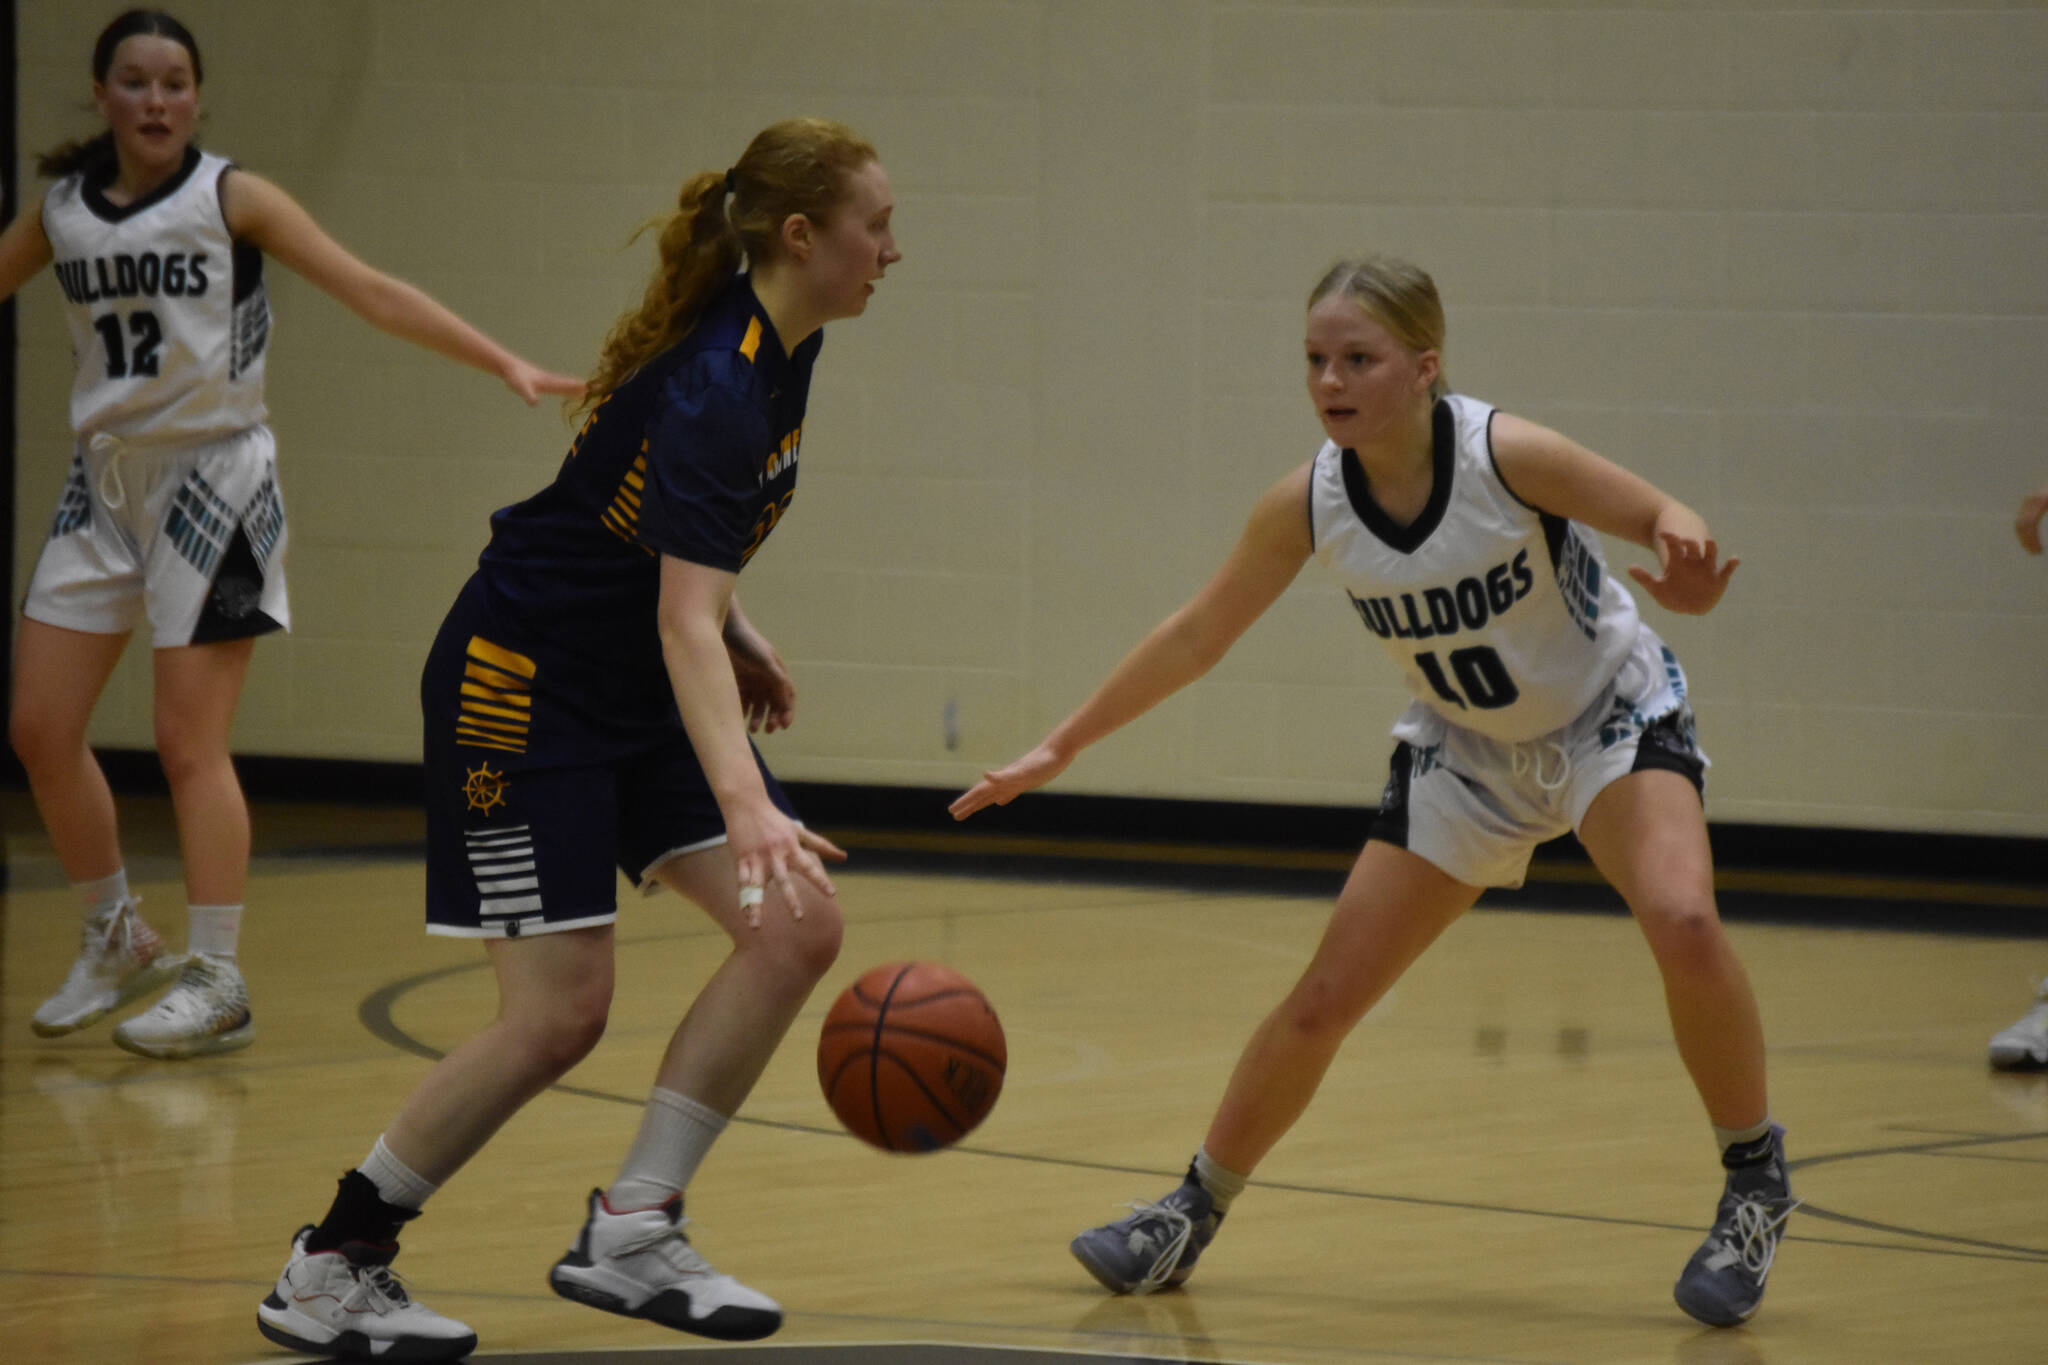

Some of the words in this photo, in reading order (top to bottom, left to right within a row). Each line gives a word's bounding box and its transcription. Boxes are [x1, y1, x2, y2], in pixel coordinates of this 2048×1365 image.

[94, 311, 163, 379] 12
[1346, 548, 1534, 639] ULLDOGS
[1414, 645, 1520, 710] 10
